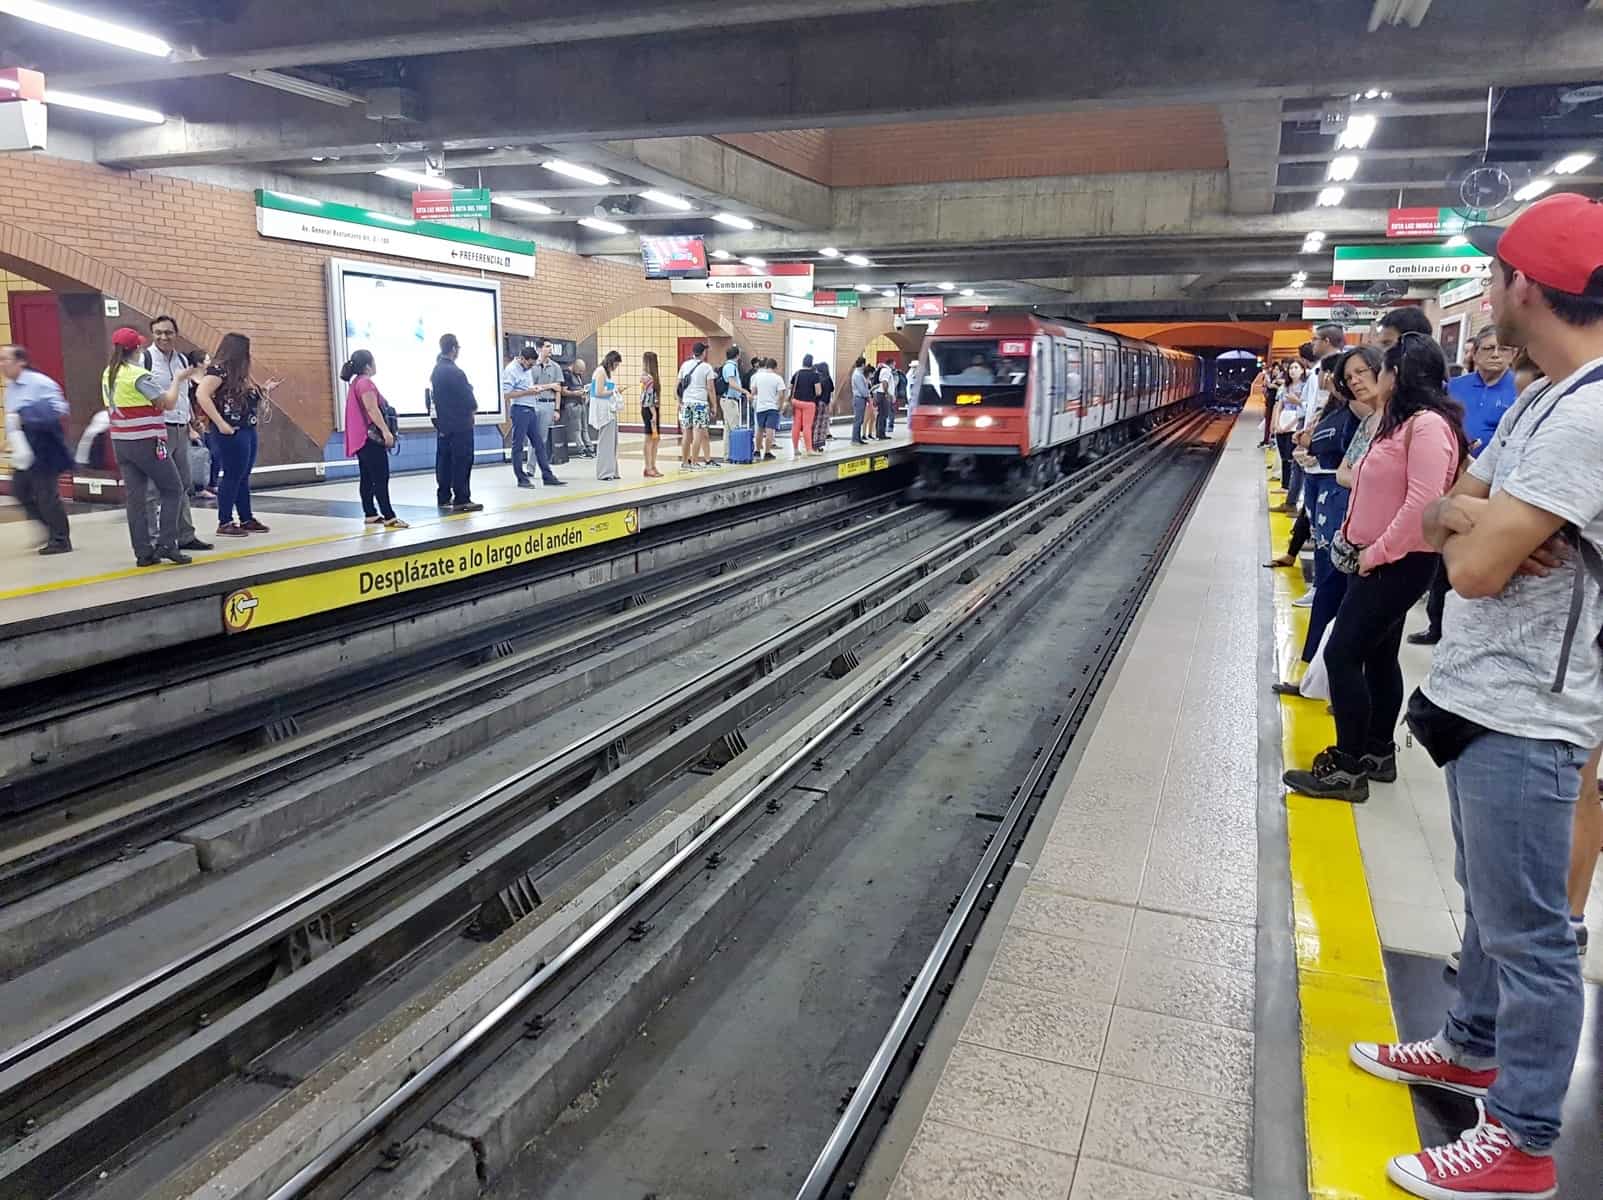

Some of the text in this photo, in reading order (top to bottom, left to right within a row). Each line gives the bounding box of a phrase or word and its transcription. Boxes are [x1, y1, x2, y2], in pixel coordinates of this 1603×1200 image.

[459, 250, 504, 266] PREFERENCIAL
[1388, 263, 1458, 274] Combinación
[715, 280, 763, 289] Combinación
[359, 527, 583, 594] Desplázate a lo largo del andén
